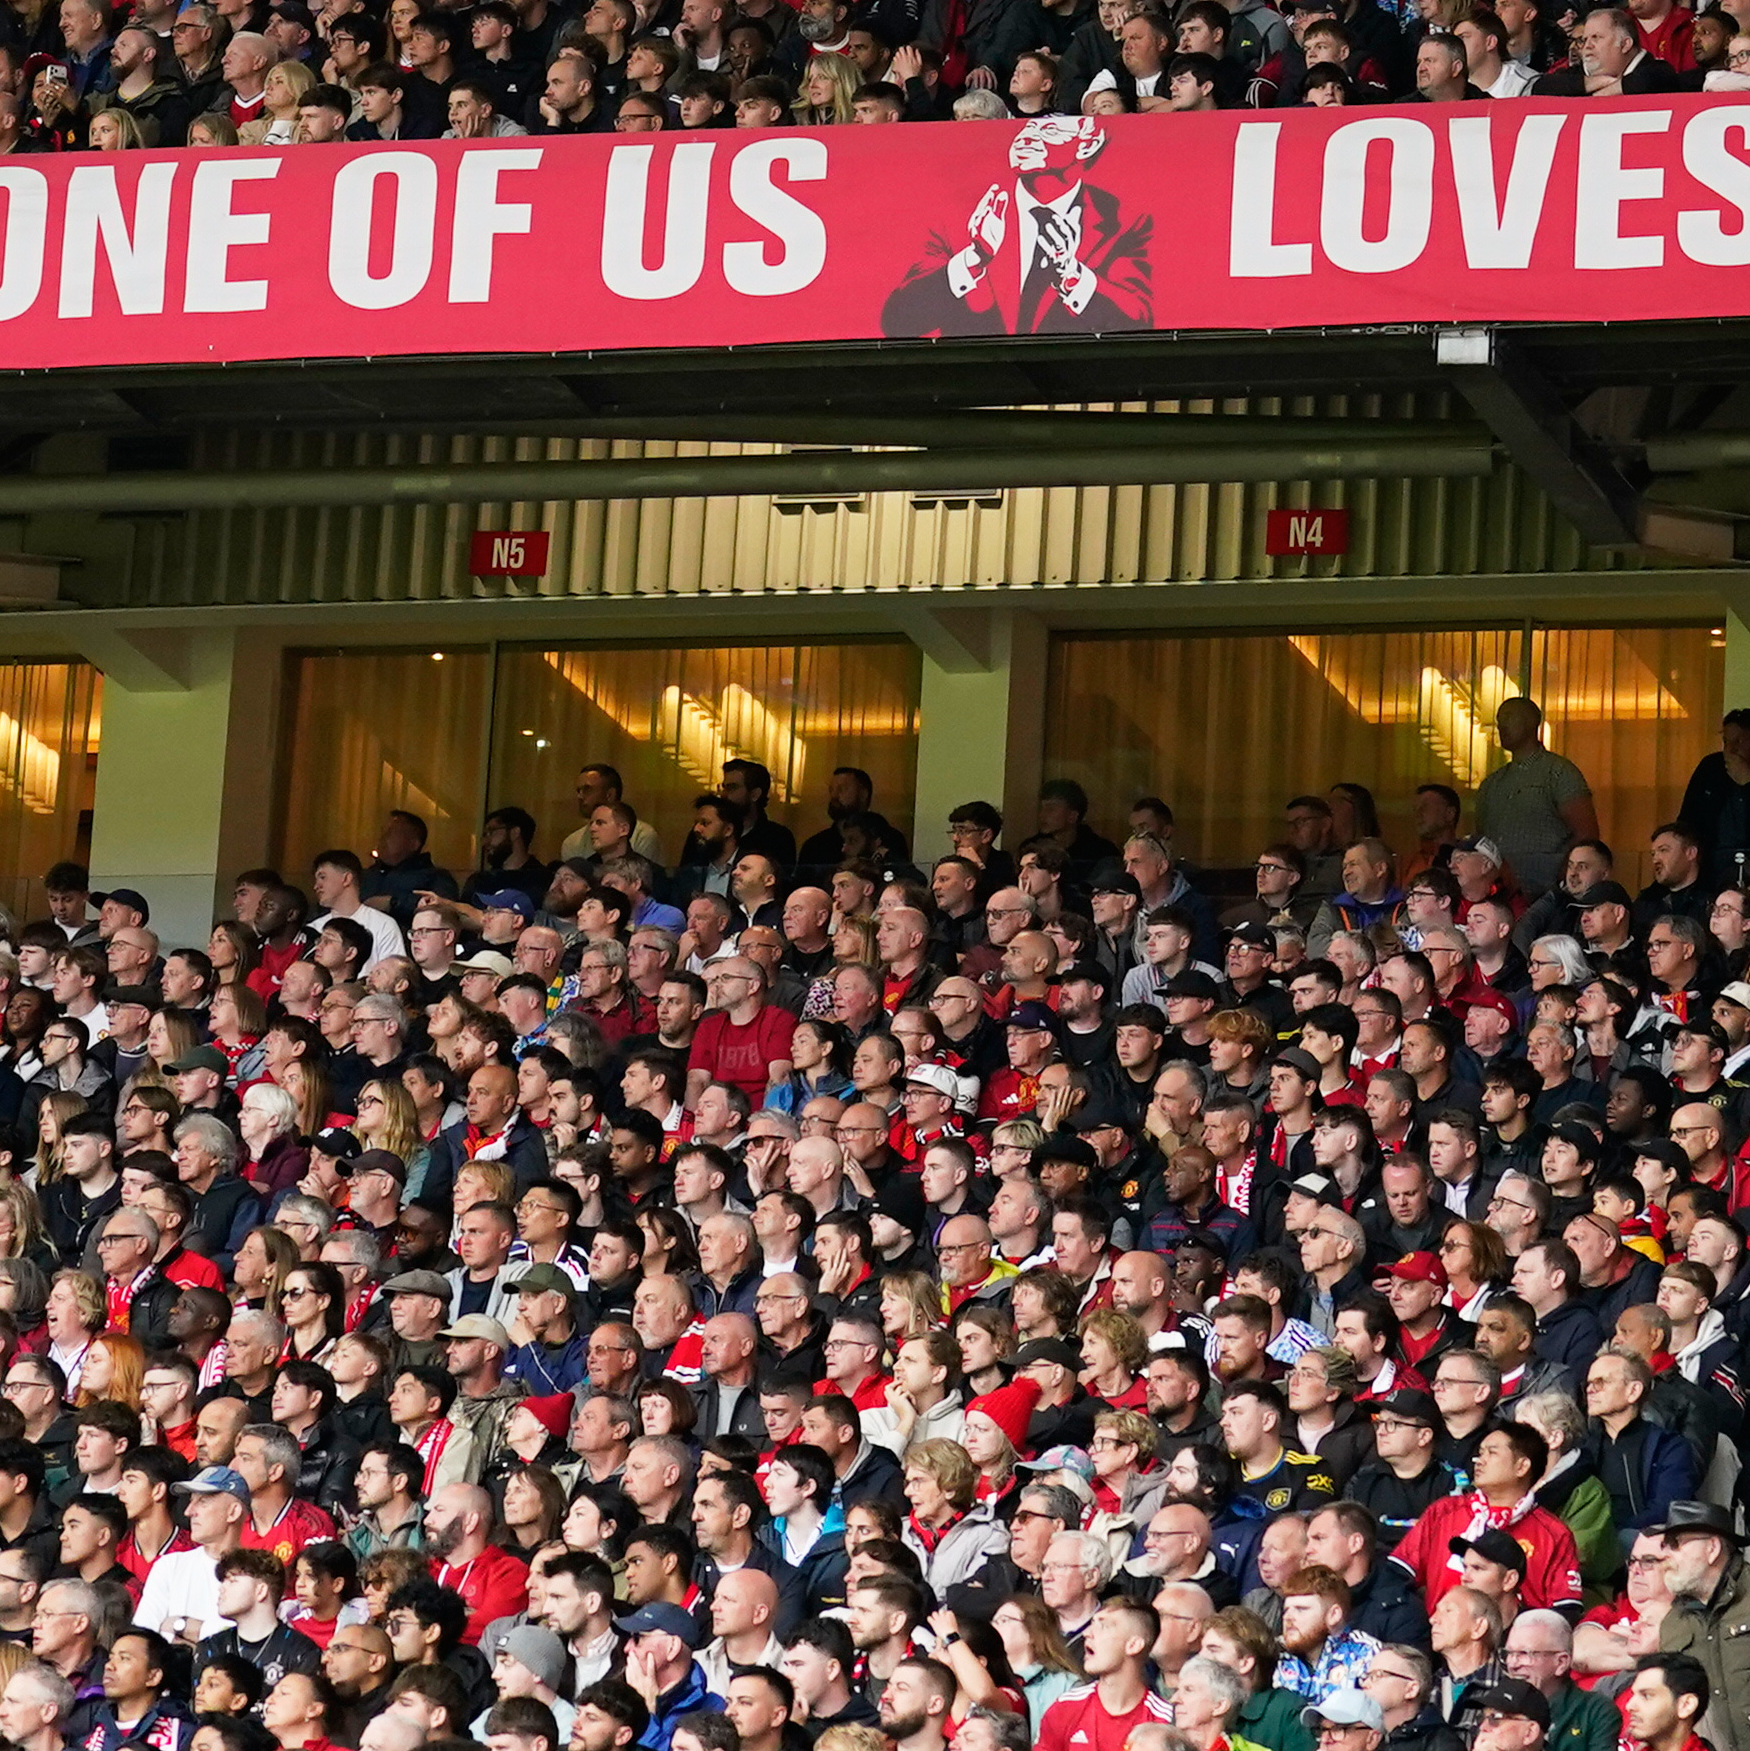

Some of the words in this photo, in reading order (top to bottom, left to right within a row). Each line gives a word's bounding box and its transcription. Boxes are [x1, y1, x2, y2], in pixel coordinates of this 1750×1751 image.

[329, 148, 544, 310] OF
[602, 138, 828, 300] US
[1289, 516, 1324, 548] N4
[492, 537, 526, 568] N5
